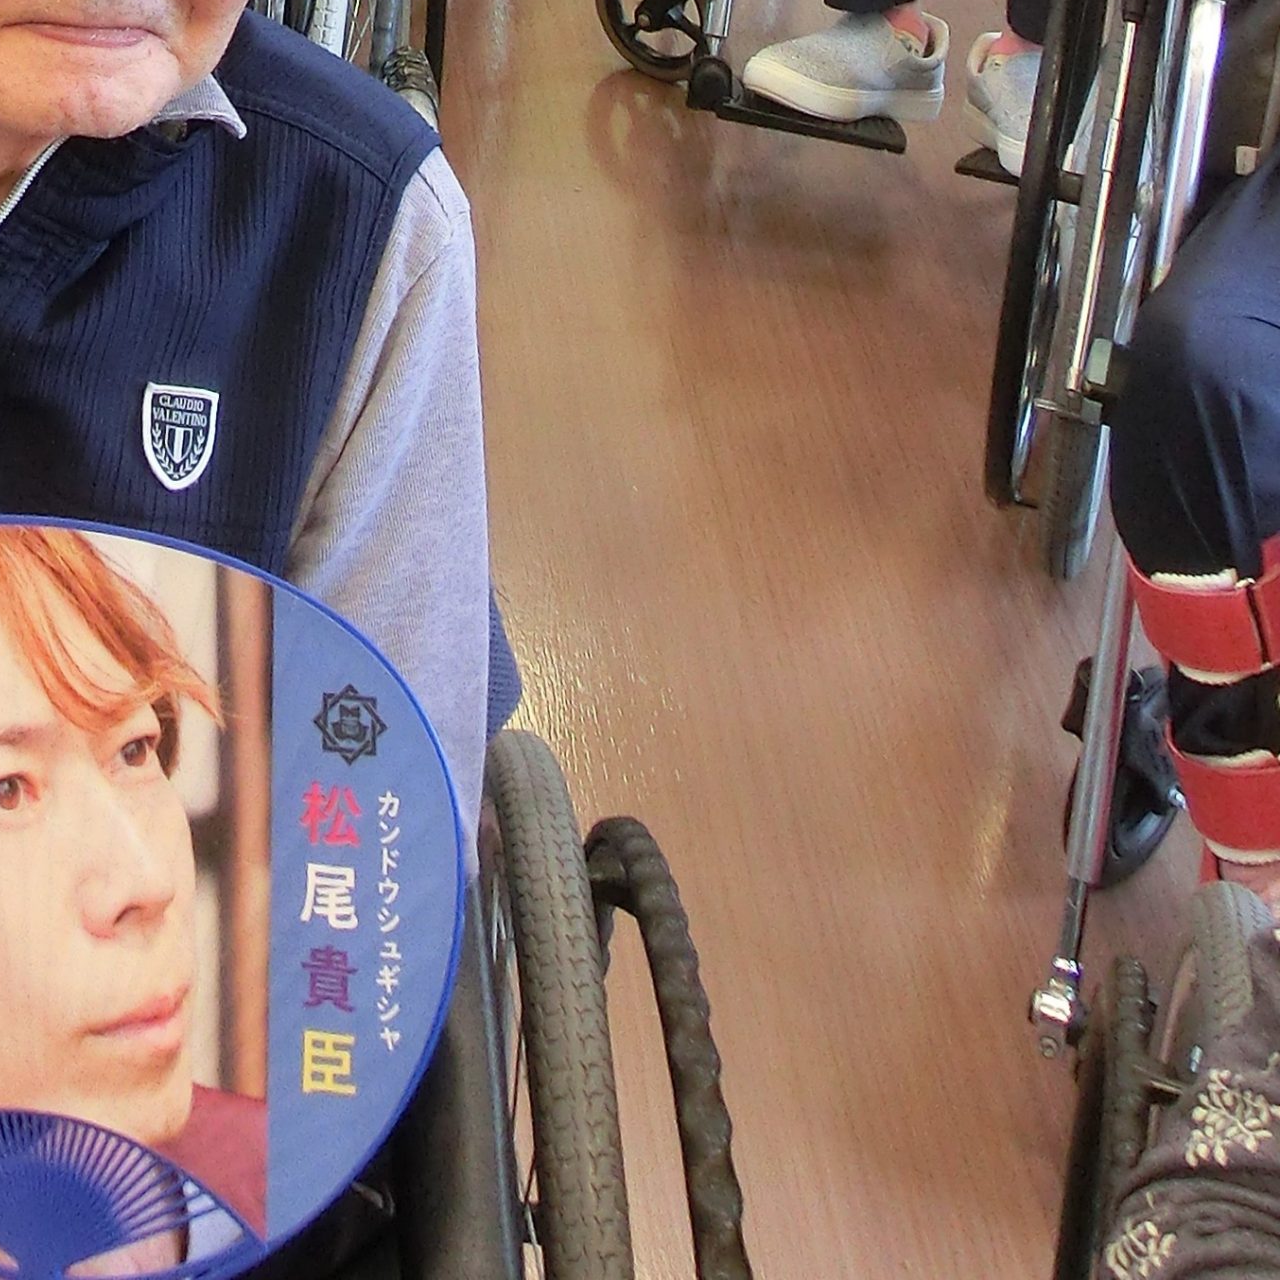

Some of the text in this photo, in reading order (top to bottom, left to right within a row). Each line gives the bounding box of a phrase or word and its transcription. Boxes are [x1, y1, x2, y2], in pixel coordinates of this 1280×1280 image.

[159, 395, 204, 412] CLAUDIO
[152, 407, 208, 427] VALENTINO
[300, 781, 362, 1096] 松尾貴臣
